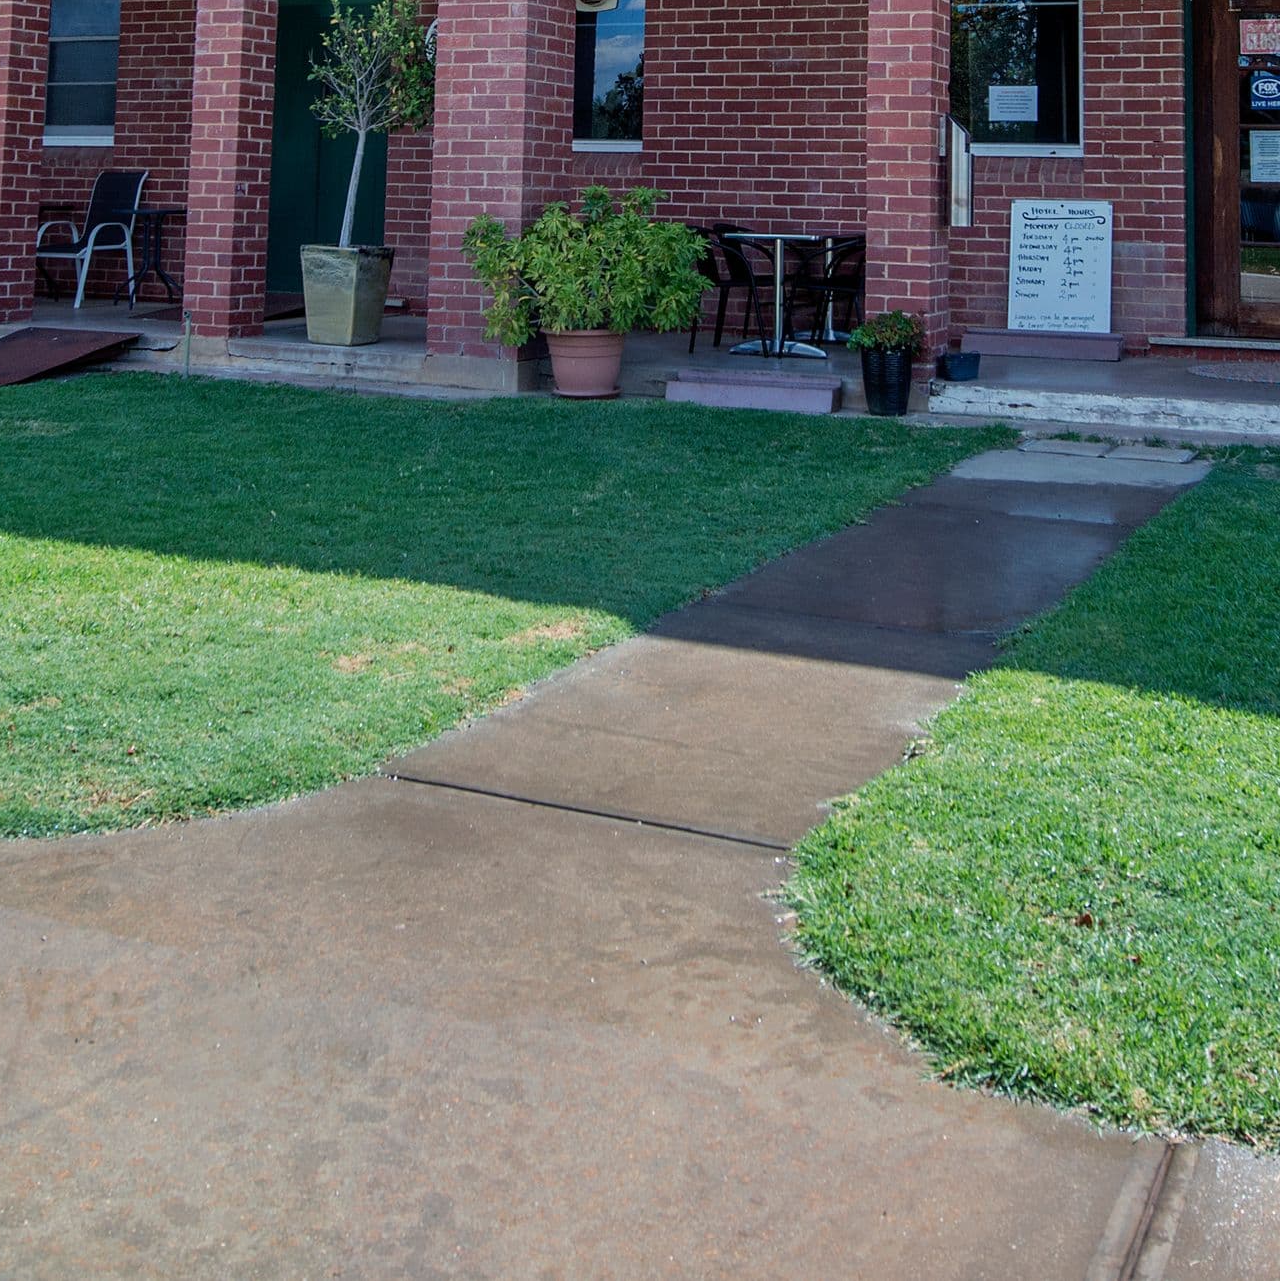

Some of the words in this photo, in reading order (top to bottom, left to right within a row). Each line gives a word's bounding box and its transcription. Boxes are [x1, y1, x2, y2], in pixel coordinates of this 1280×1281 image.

[1258, 82, 1278, 92] FOX
[1031, 207, 1058, 215] HOTEL
[1068, 208, 1095, 216] HOURS
[1064, 222, 1095, 230] CLOSED
